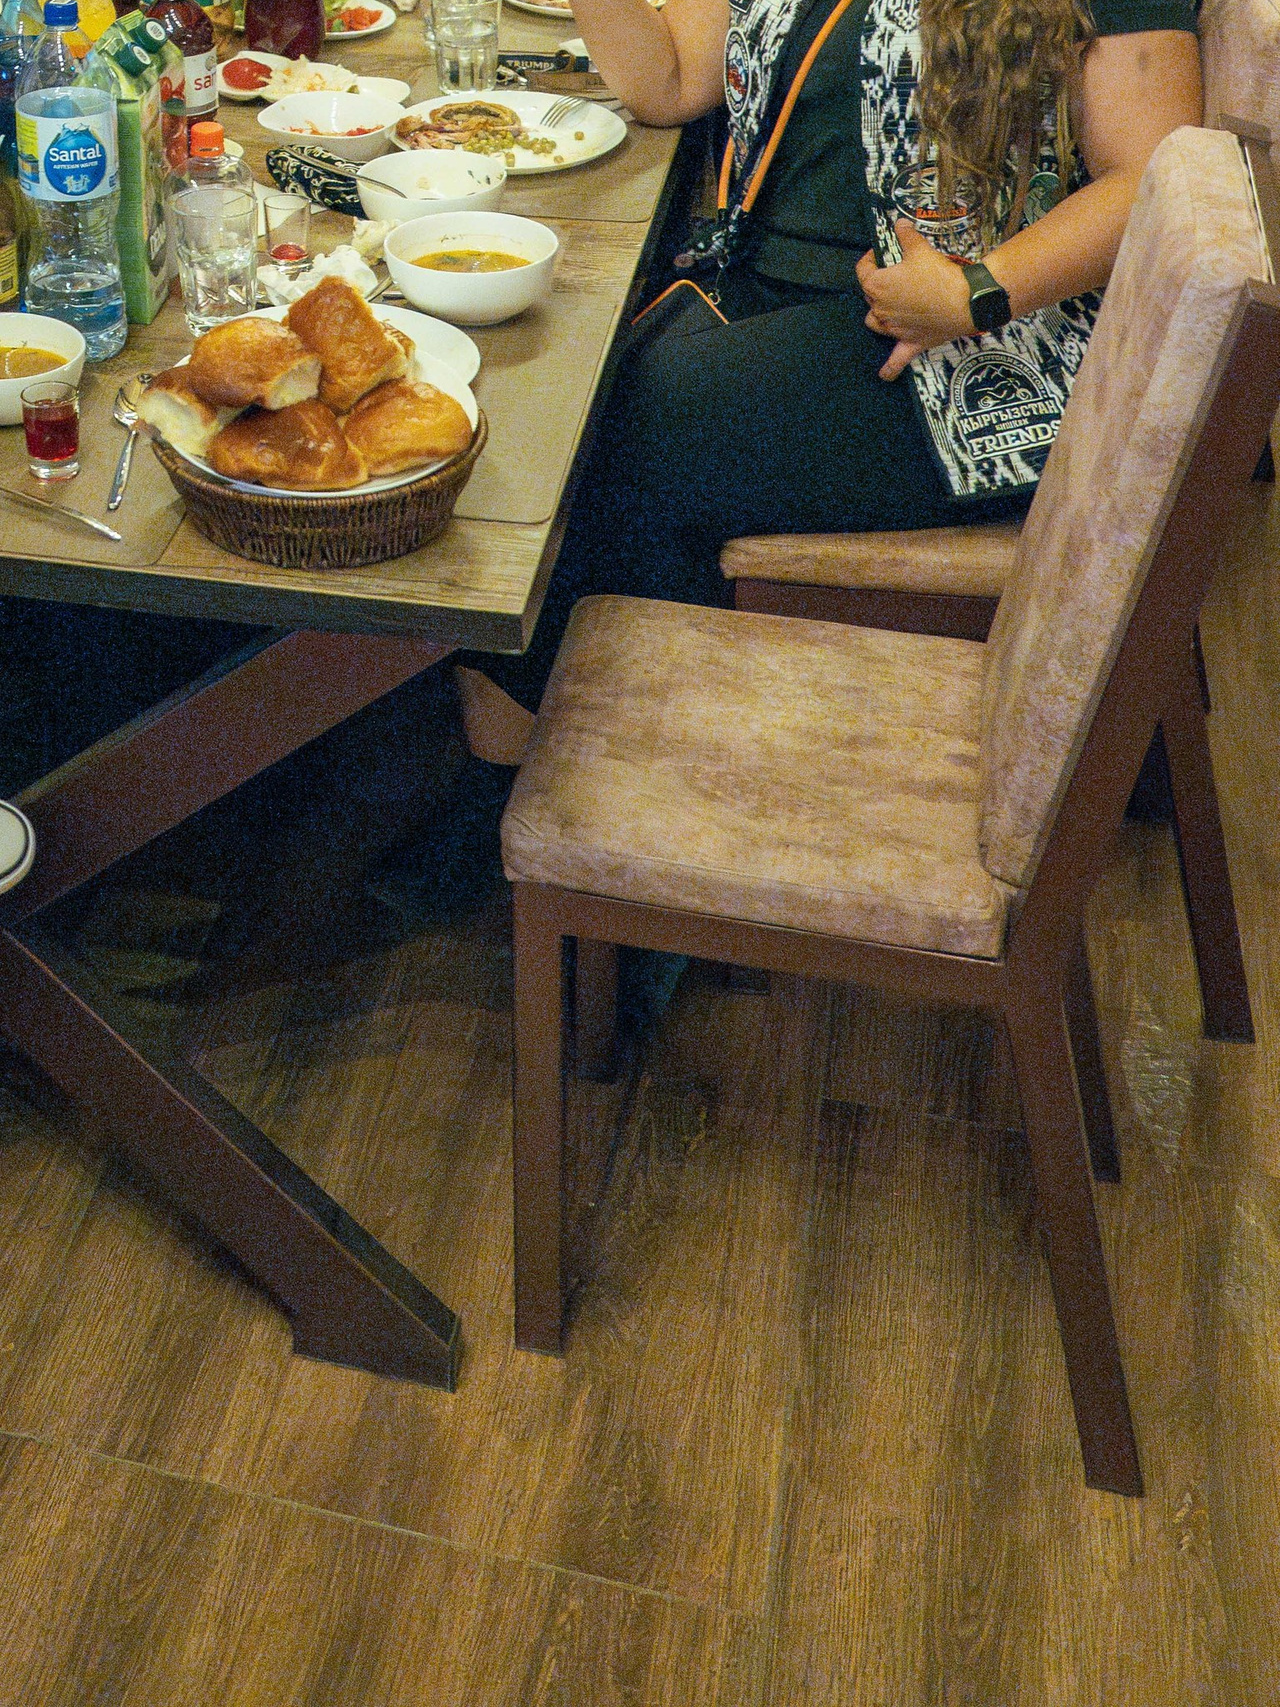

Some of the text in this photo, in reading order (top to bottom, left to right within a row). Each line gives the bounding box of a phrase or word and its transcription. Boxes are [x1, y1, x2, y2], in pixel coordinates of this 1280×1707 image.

[49, 143, 102, 162] Santal
[960, 399, 1059, 434] КЫРГЫЗСТАН
[968, 419, 1061, 456] FRIENDS
